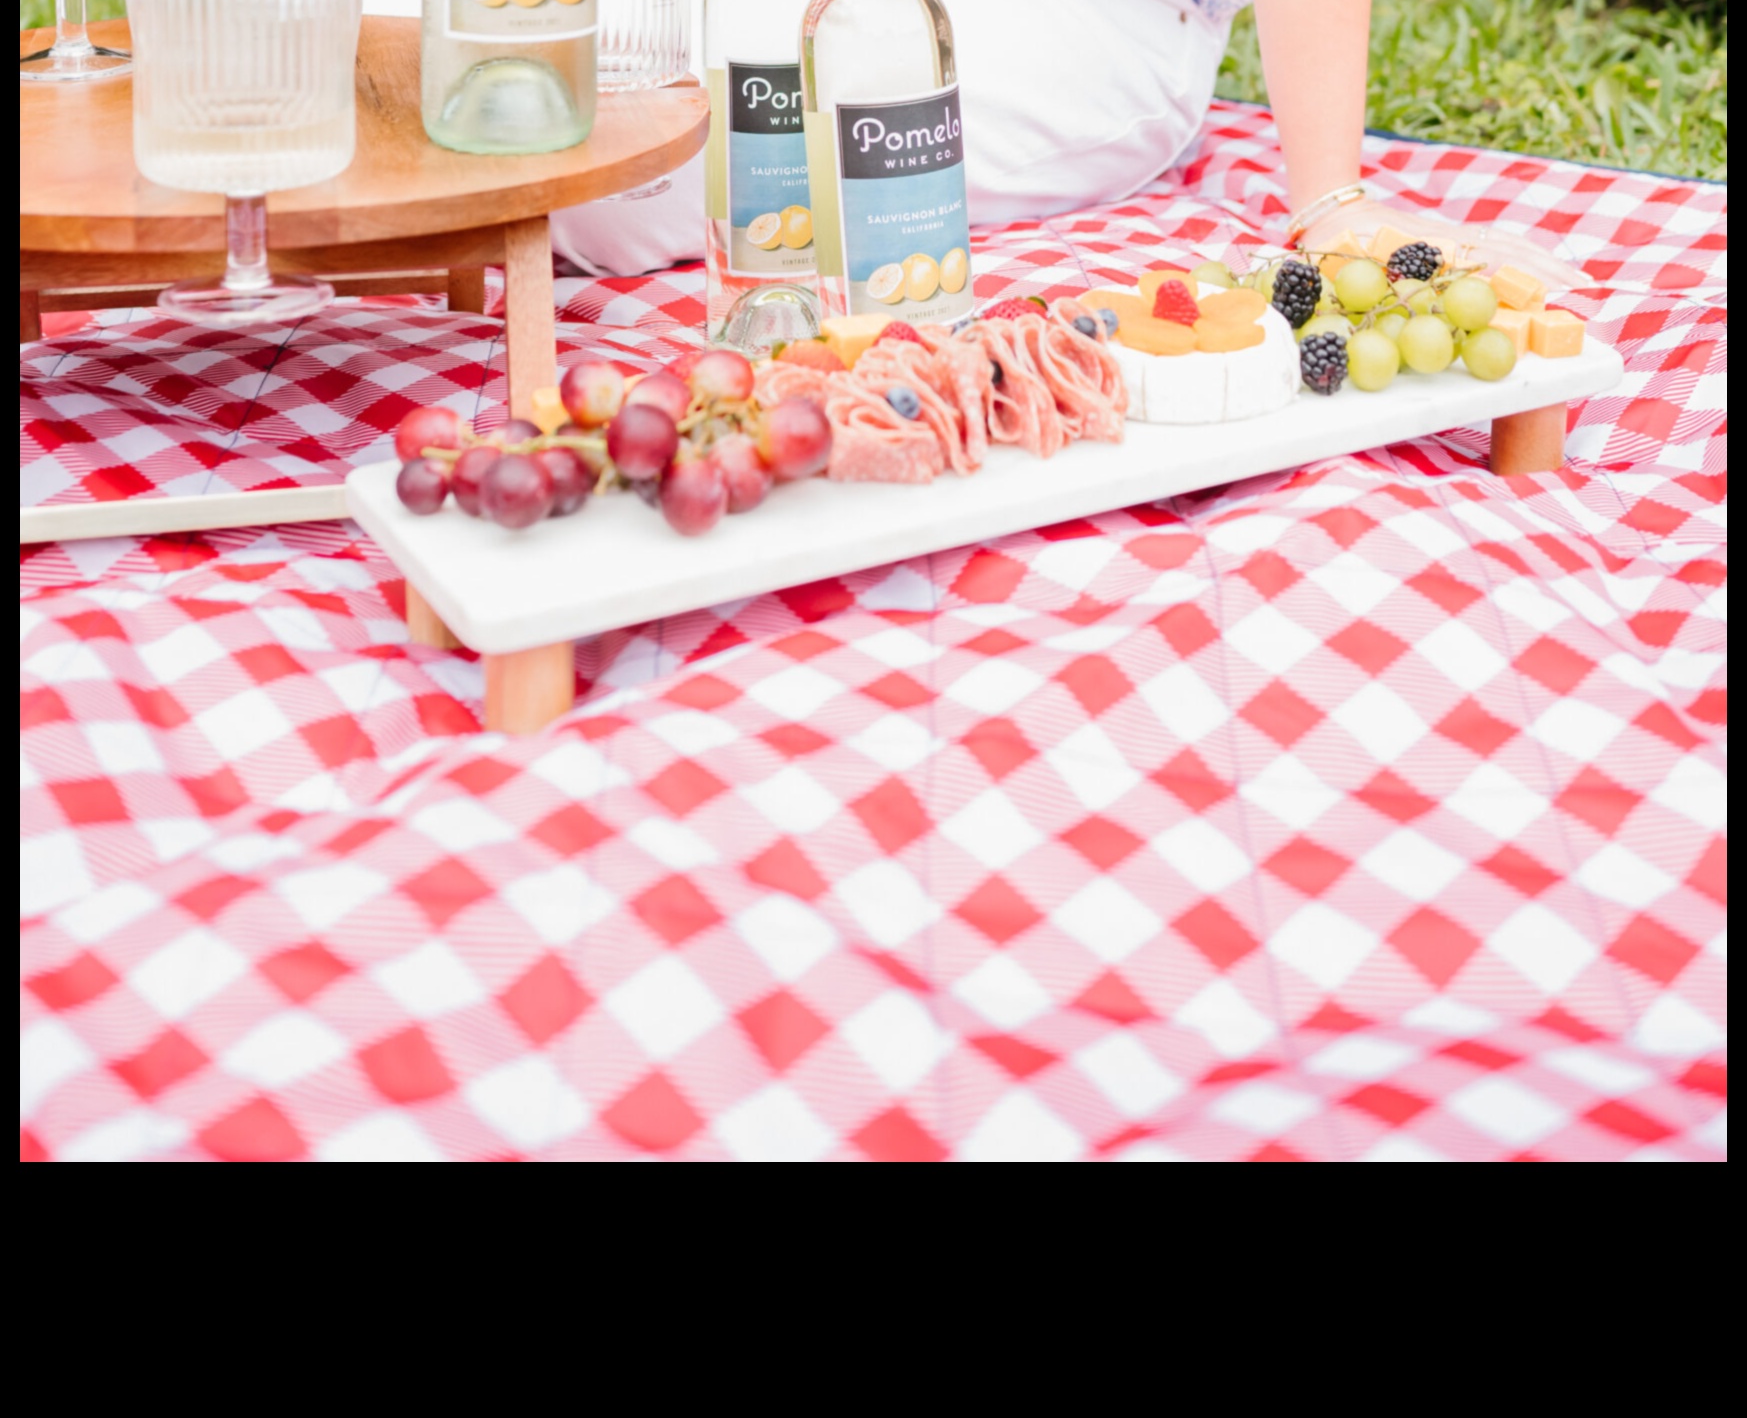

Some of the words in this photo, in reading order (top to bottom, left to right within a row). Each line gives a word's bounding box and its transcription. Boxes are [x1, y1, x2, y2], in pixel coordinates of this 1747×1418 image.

[852, 106, 960, 153] Pomelo
[884, 155, 928, 169] WINE
[936, 149, 954, 161] CO.
[867, 209, 936, 224] SAUVIGNON
[938, 199, 963, 215] BLANC
[901, 221, 945, 234] CALIFORNIA
